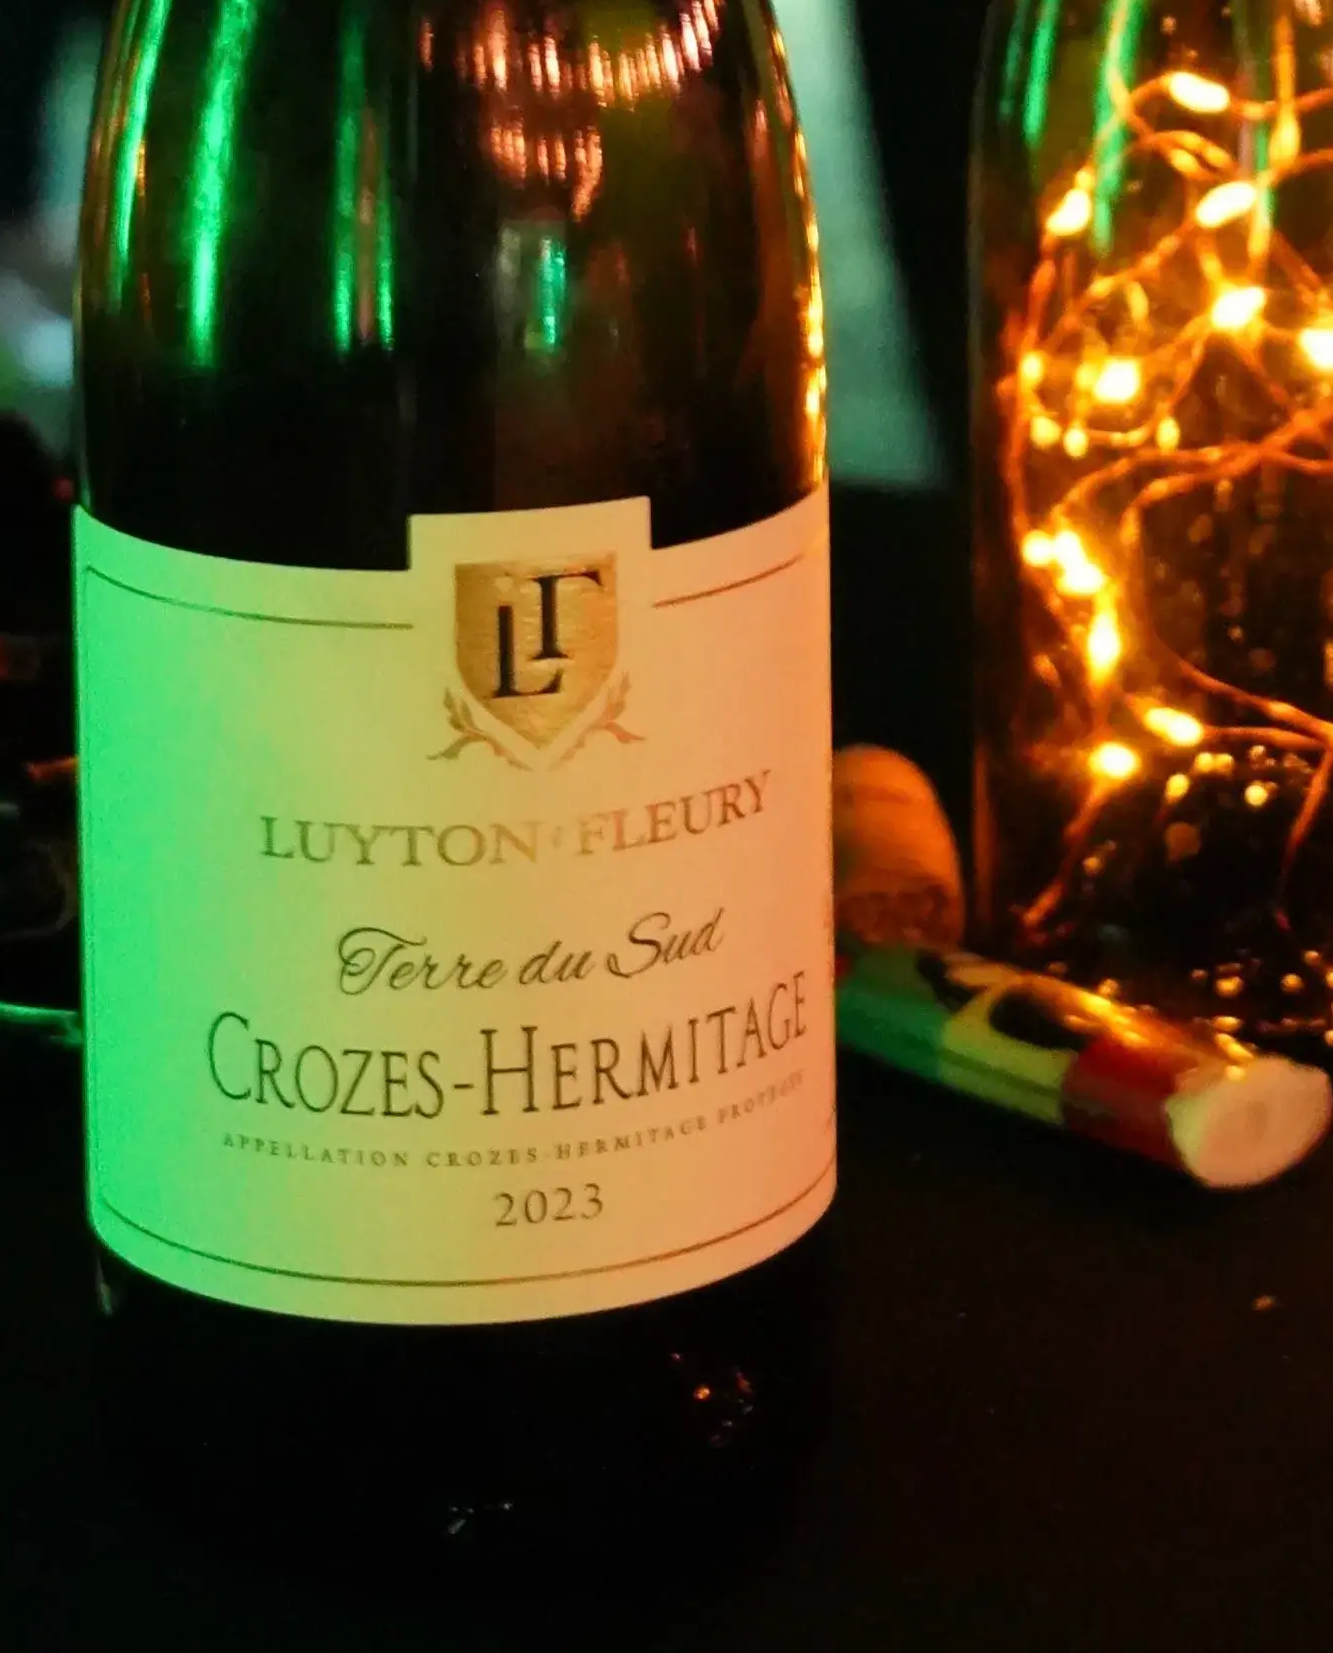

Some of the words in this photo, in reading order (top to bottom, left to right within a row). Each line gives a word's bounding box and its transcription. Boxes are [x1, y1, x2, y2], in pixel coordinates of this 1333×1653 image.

[260, 815, 543, 868] LUYTON
[571, 769, 773, 858] FLEURY
[338, 926, 509, 996] Terre
[517, 938, 596, 987] du
[605, 906, 725, 979] Sud
[207, 969, 808, 1120] CROZES-HERMITAGE
[222, 1131, 409, 1168] APPELLATION
[494, 1182, 605, 1228] 2023
